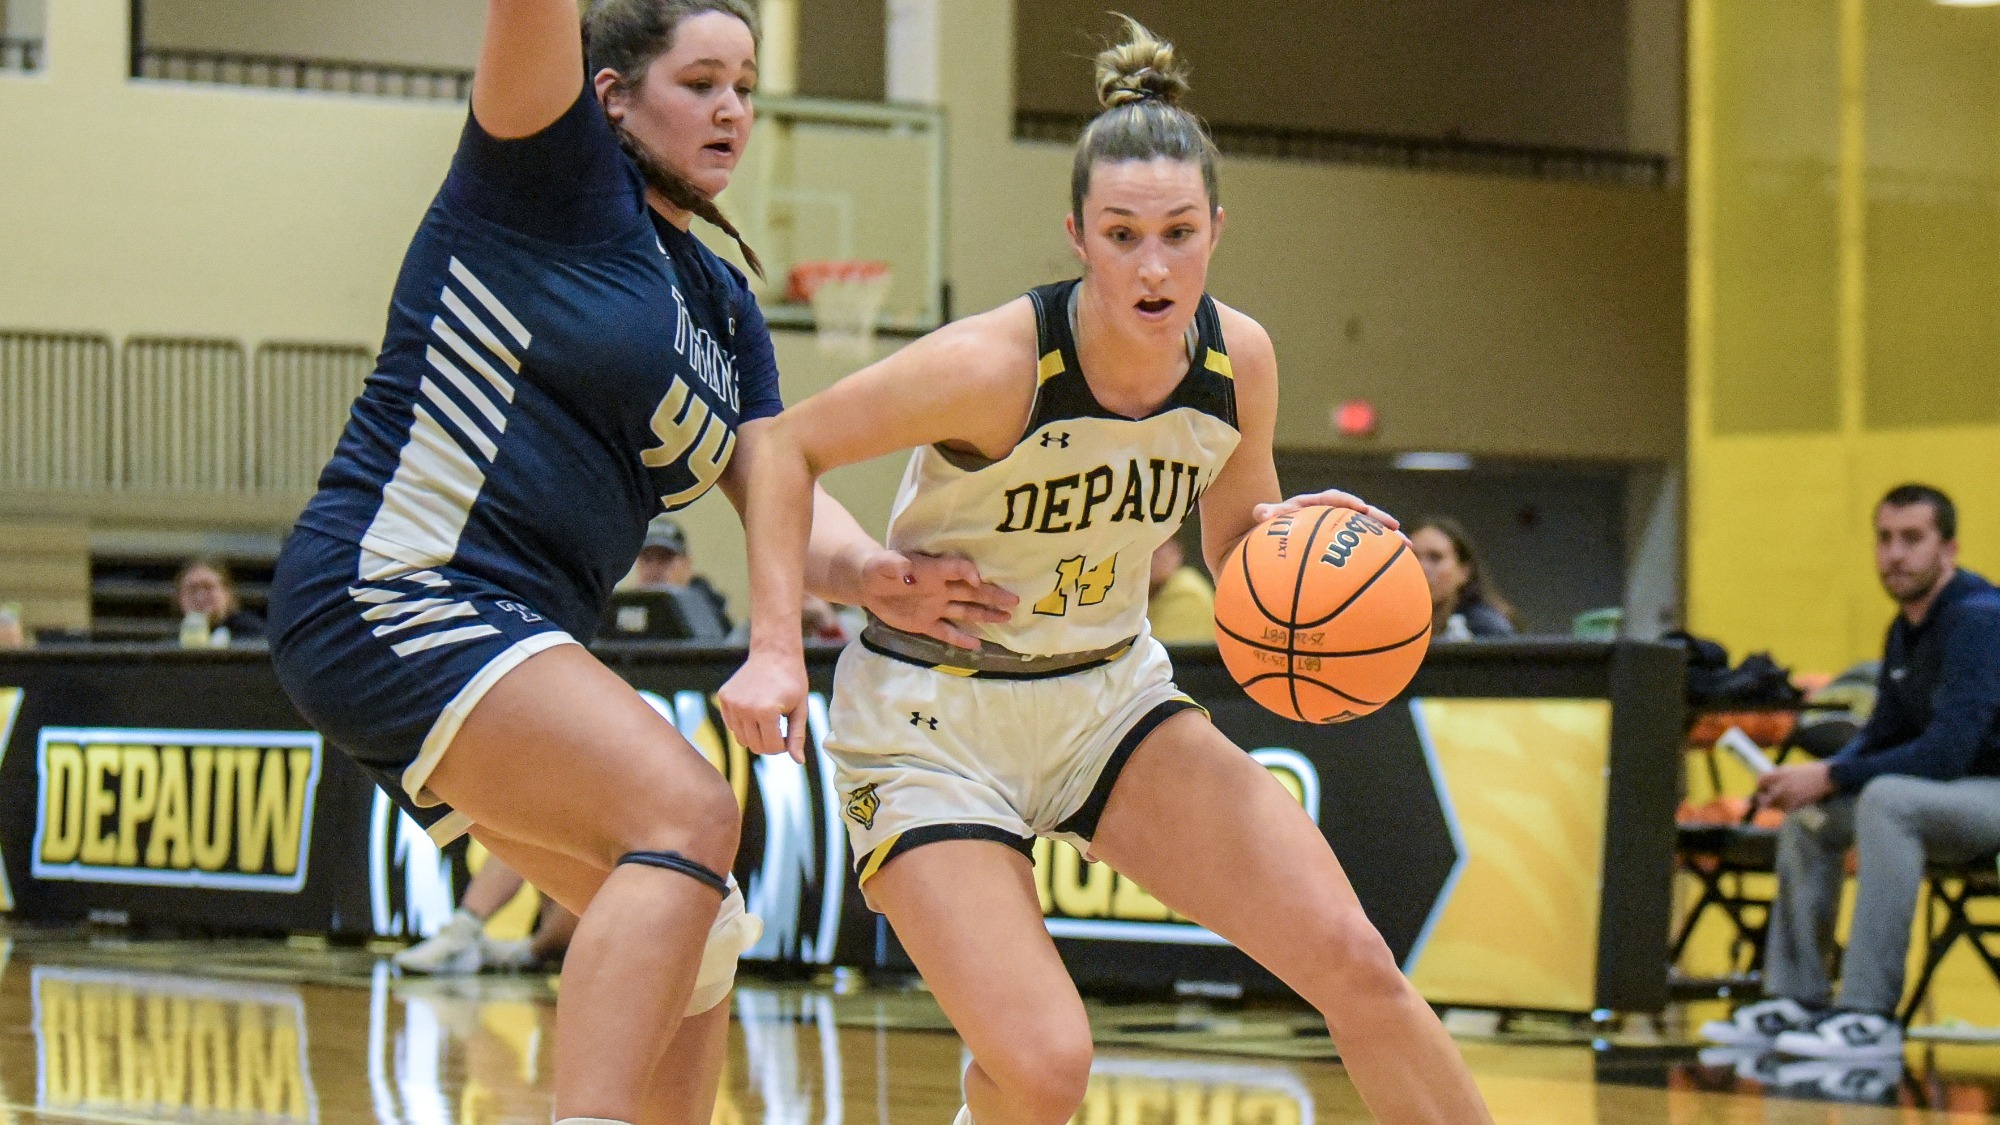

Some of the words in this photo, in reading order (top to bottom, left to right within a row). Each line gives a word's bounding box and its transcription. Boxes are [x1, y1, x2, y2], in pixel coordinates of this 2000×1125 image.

[639, 373, 737, 509] 44
[1032, 552, 1119, 617] 14
[1320, 512, 1384, 568] lson
[41, 744, 312, 874] DEPAUW
